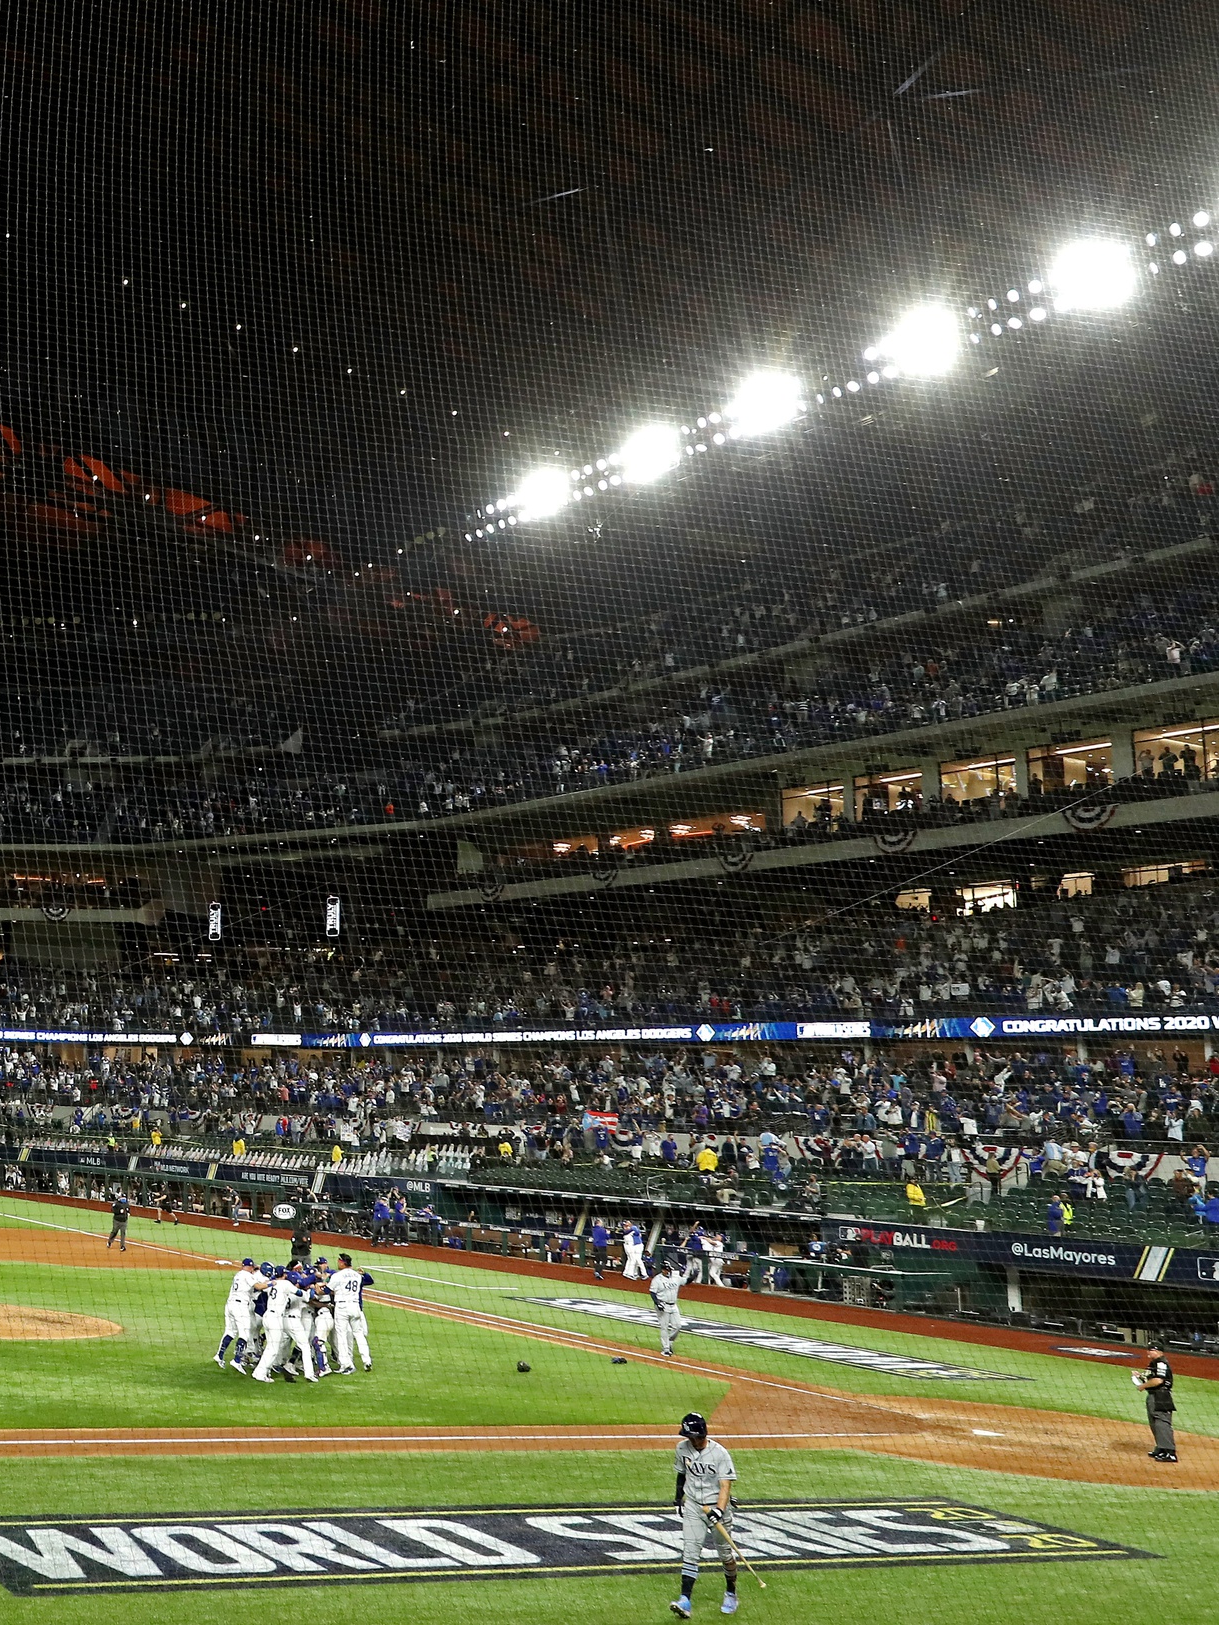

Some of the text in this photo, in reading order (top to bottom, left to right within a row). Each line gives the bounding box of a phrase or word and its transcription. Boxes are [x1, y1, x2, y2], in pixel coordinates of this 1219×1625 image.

[1003, 1018, 1161, 1033] CONGRATULATIONS
[1162, 1016, 1209, 1030] 2020
[4, 1031, 35, 1040] SERIES
[36, 1032, 87, 1042] CHAMPIONS
[89, 1033, 103, 1042] LOS
[104, 1033, 138, 1042] ANGELES
[373, 1034, 442, 1045] CONGRATULATIONS
[463, 1033, 492, 1042] WORLD
[493, 1032, 522, 1042] SERIES
[523, 1031, 575, 1041] CHAMPIONS
[576, 1030, 596, 1040] LOS
[596, 1029, 641, 1040] ANGELES
[642, 1028, 692, 1039] DODGERS
[86, 1156, 101, 1166] MLB
[406, 1181, 431, 1193] @MLB
[861, 1228, 958, 1251] PLAYBALL.ORG
[1011, 1242, 1116, 1266] @LasMayores
[344, 1280, 358, 1292] 48
[682, 1455, 716, 1477] RAYS
[918, 1507, 997, 1521] 20
[525, 1509, 1010, 1561] SERIES
[1015, 1533, 1099, 1549] 20
